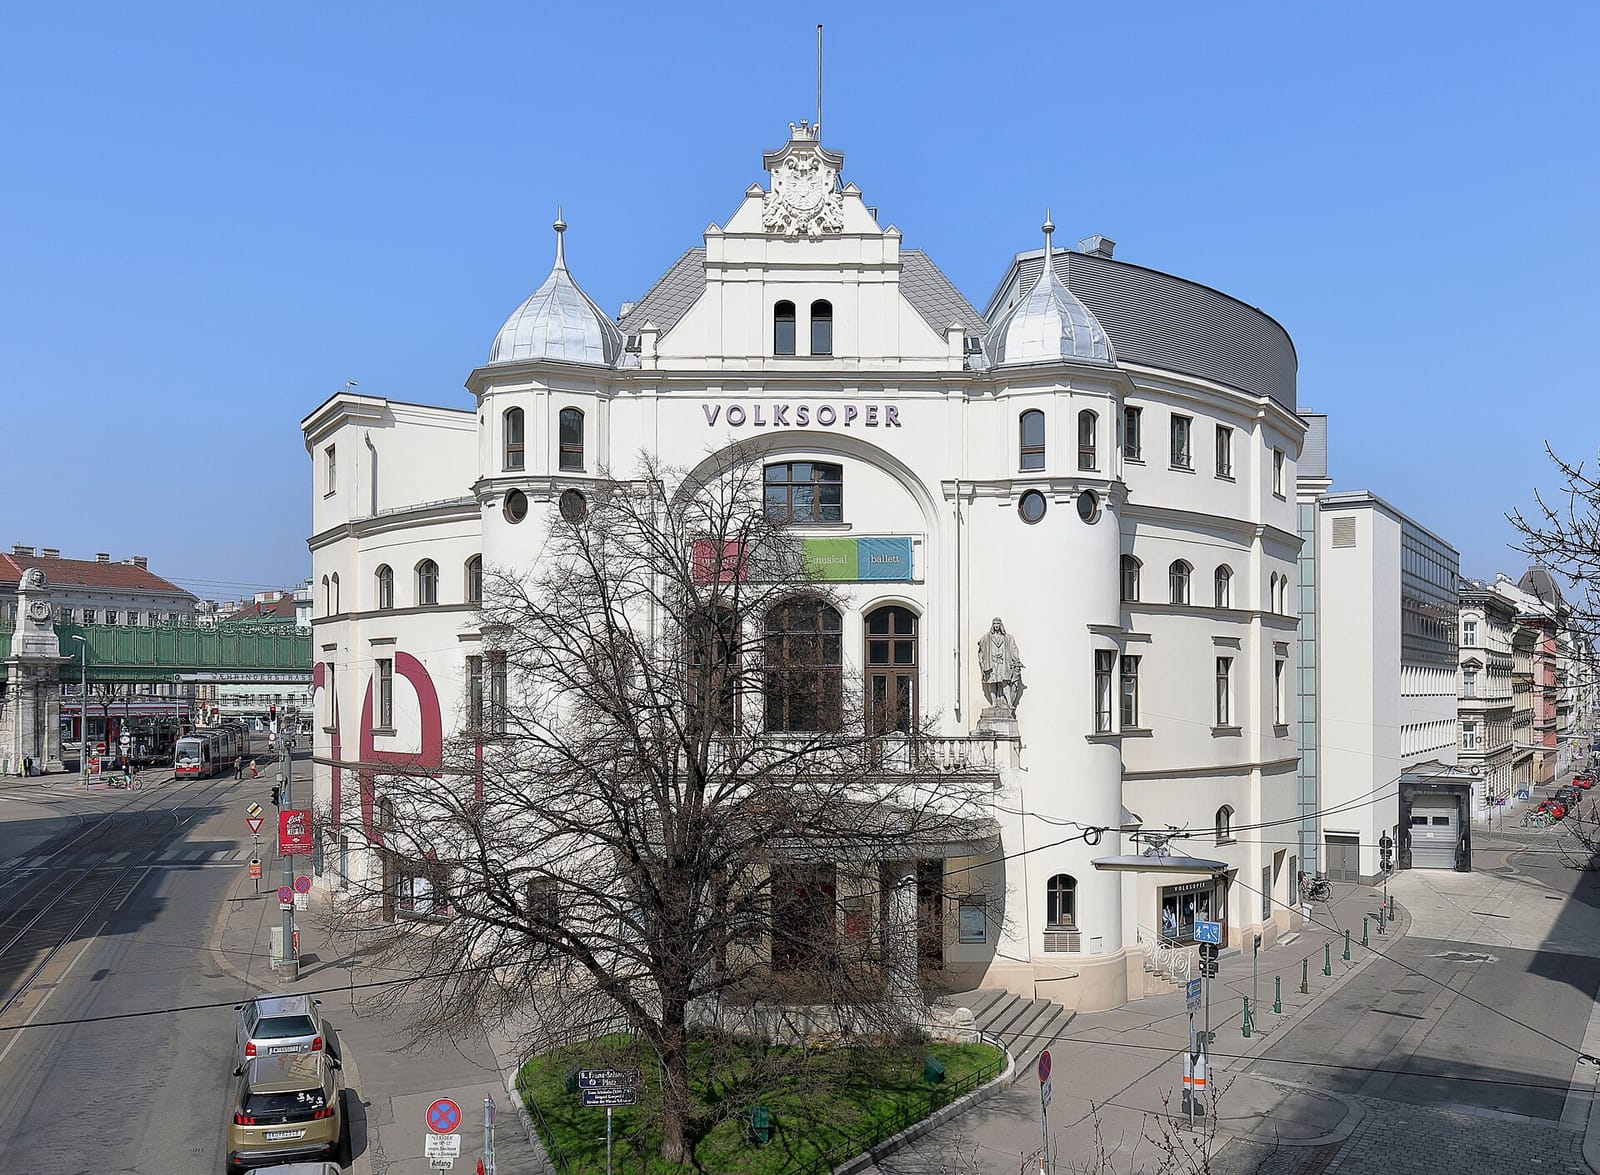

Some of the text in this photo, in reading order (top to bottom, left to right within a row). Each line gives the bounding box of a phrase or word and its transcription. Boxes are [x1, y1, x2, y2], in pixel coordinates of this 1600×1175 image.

[701, 404, 902, 428] VOLKSOPER
[812, 555, 848, 564] musical
[870, 554, 900, 563] ballett
[1174, 882, 1206, 892] VOLKSOPER
